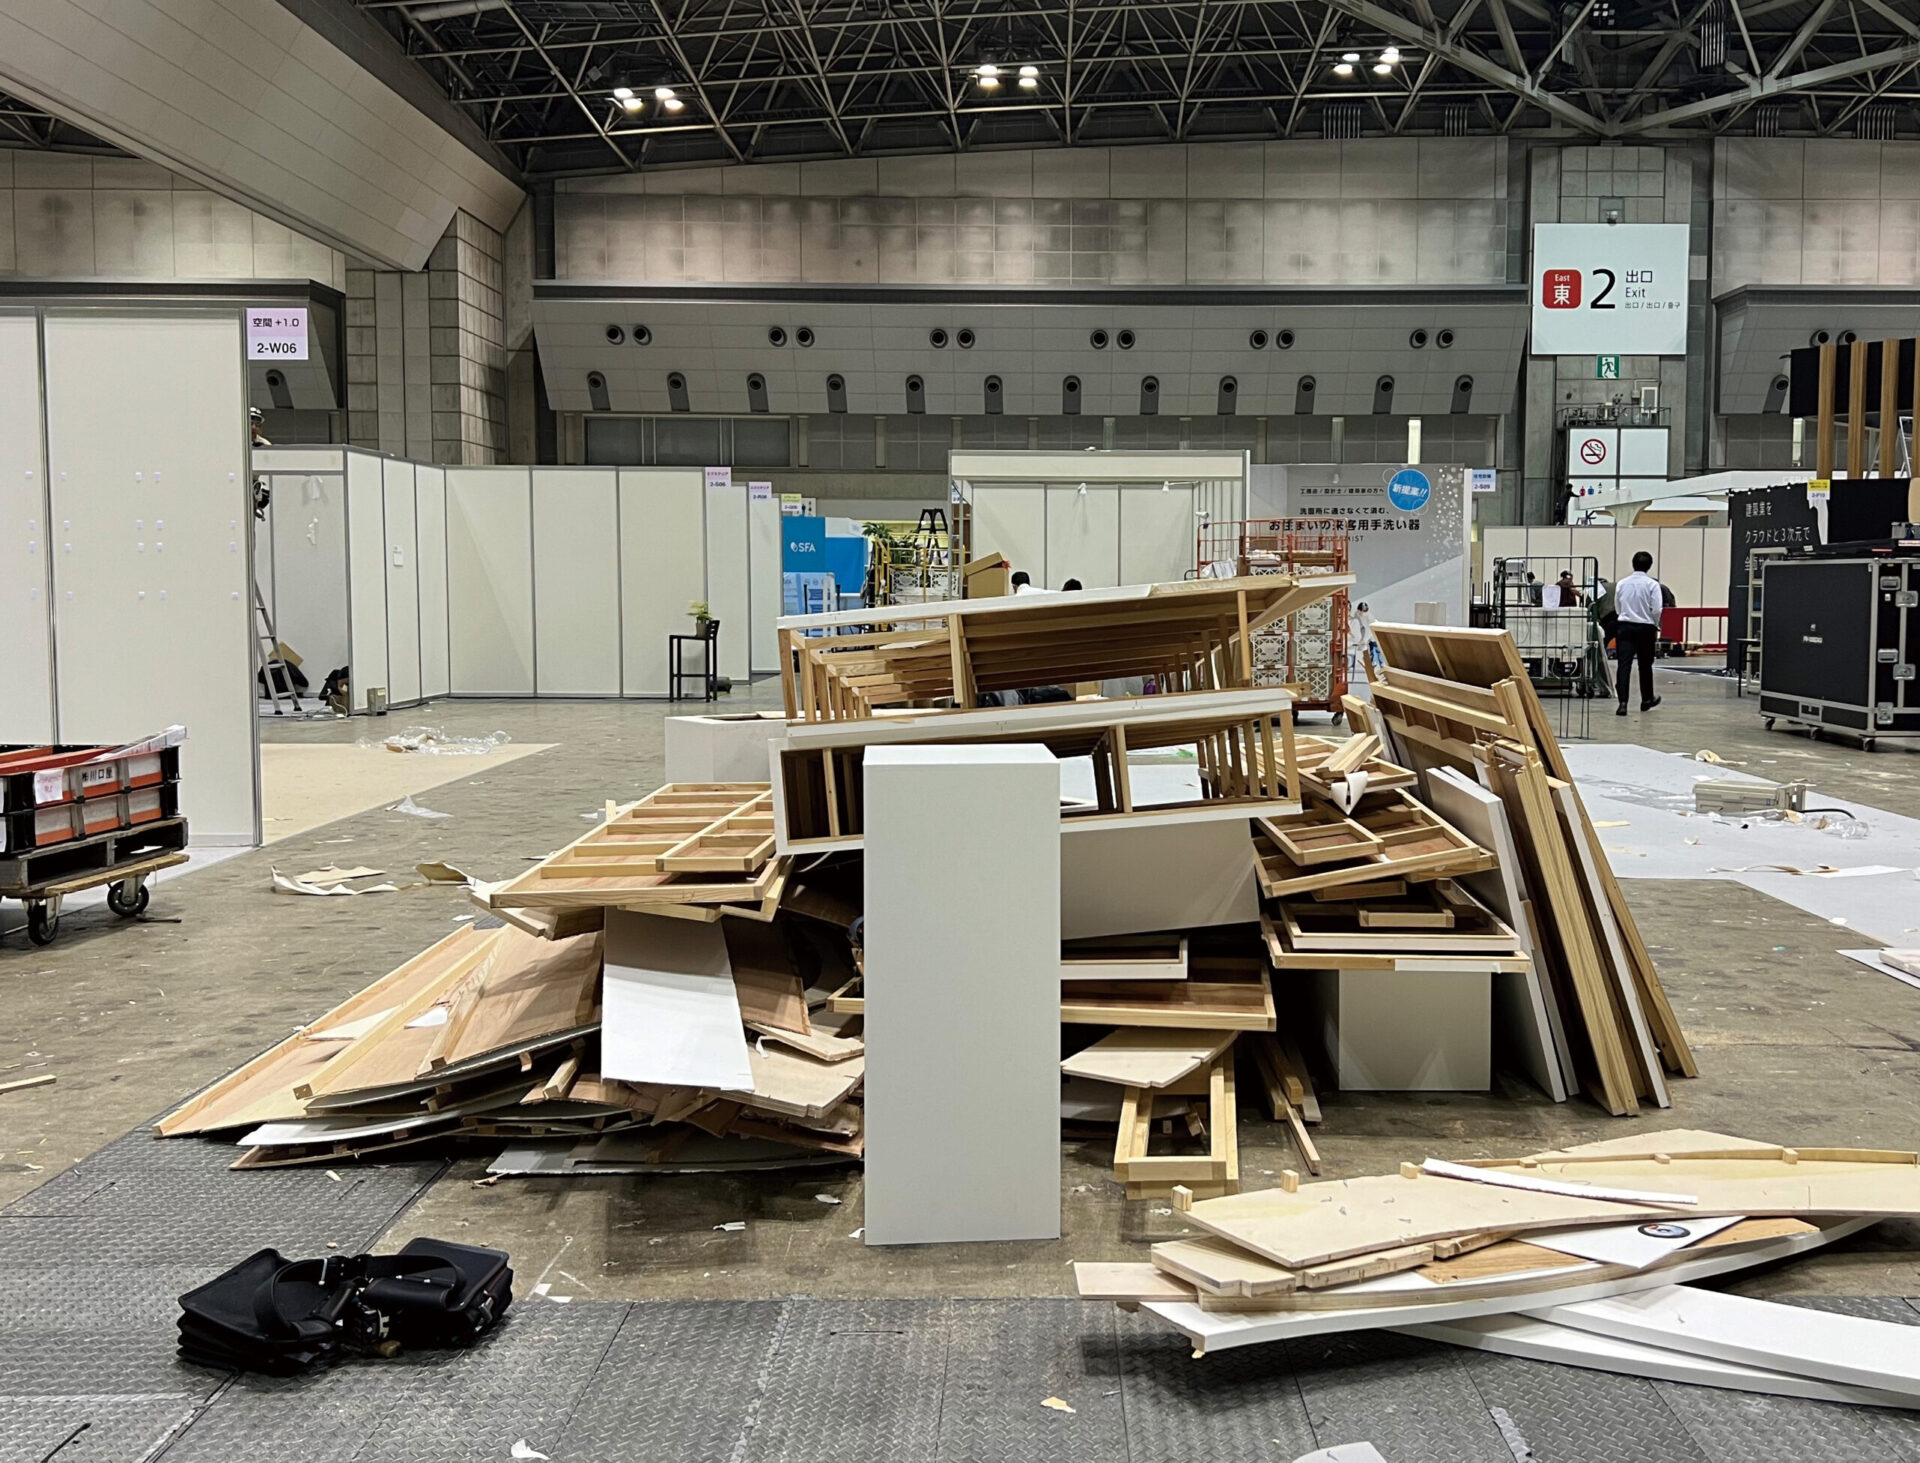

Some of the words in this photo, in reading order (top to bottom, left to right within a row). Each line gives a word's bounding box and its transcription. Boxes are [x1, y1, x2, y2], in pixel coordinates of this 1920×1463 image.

[1554, 274, 1571, 282] East
[1626, 270, 1652, 283] 出口
[1553, 283, 1571, 306] 東
[1590, 268, 1616, 309] 2
[1625, 287, 1645, 298] Exit
[257, 342, 297, 354] 2-W06
[1745, 526, 1810, 543] クラウドと3次元で
[798, 543, 816, 553] SFA
